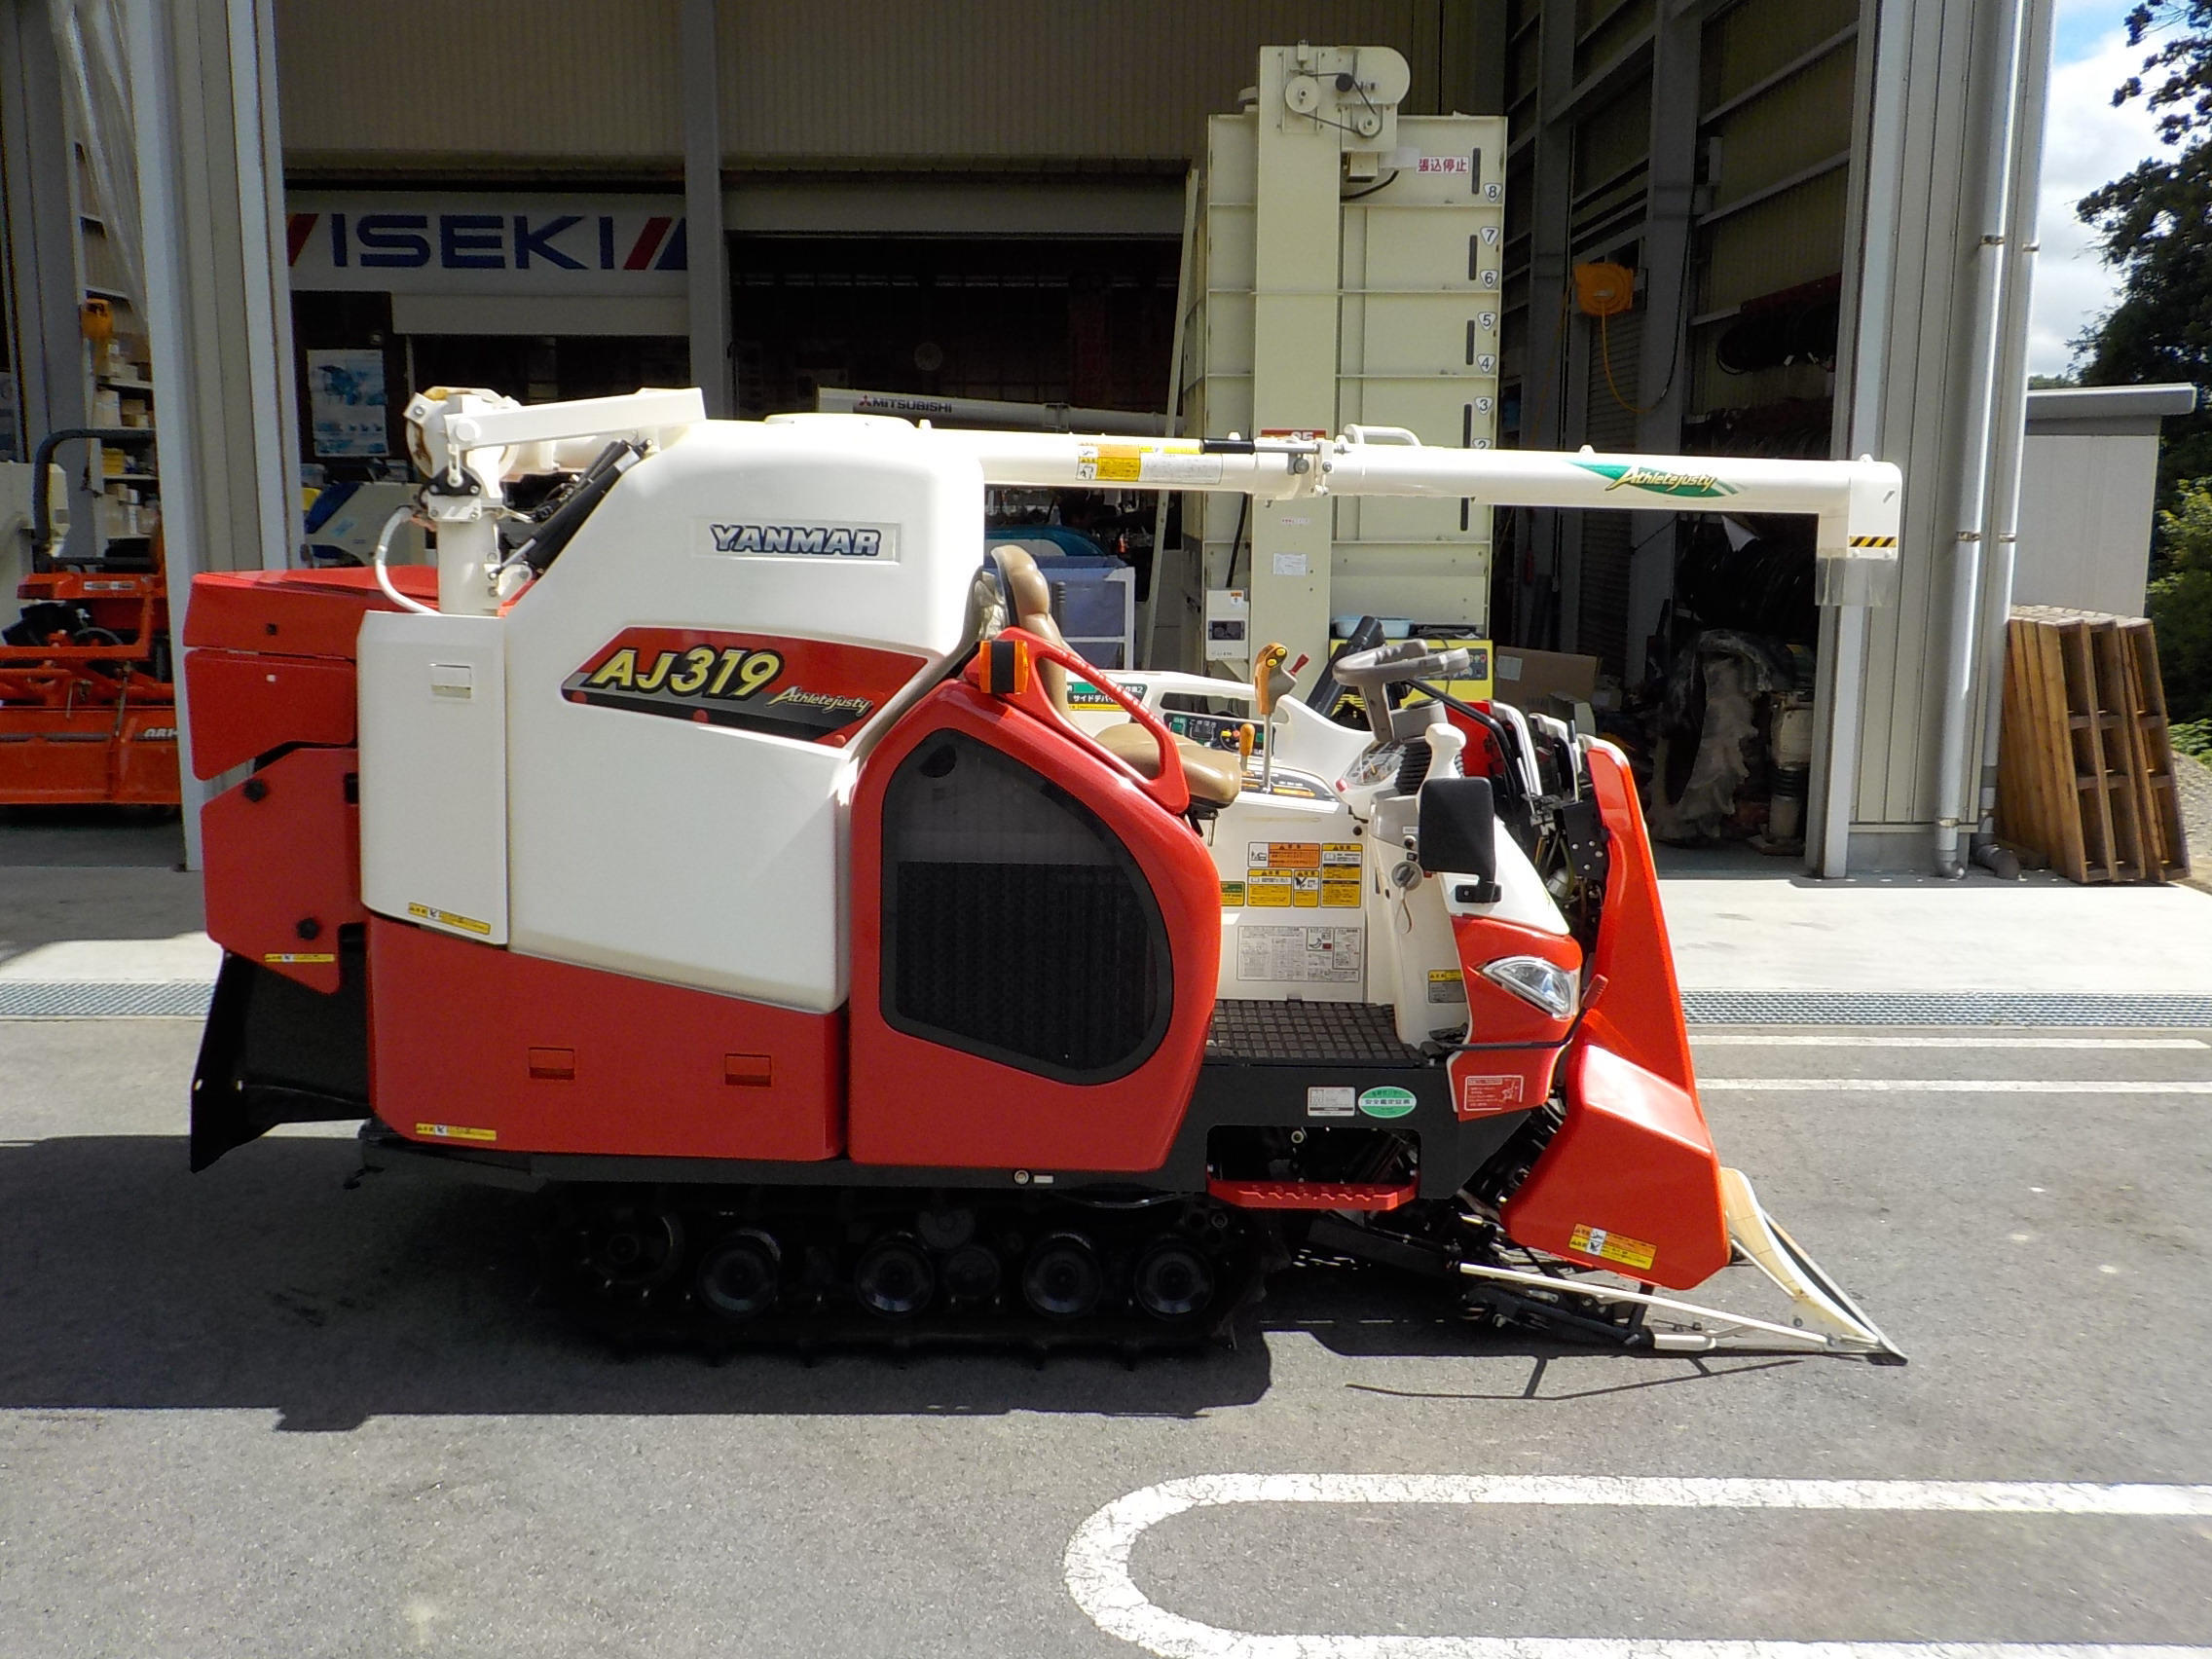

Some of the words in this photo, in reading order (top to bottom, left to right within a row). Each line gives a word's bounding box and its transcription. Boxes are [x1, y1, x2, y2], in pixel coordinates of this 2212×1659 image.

[1419, 158, 1467, 172] 張込停止
[1488, 185, 1497, 199] 8
[331, 213, 615, 271] ISEKI
[1486, 229, 1495, 242] 7
[1484, 272, 1493, 285] 6
[1482, 313, 1492, 327] 5
[1481, 356, 1491, 370] 4
[872, 397, 952, 413] MITSUBISHI
[1479, 398, 1489, 412] 3
[710, 524, 882, 556] YANMAR
[586, 645, 782, 698] AJ319
